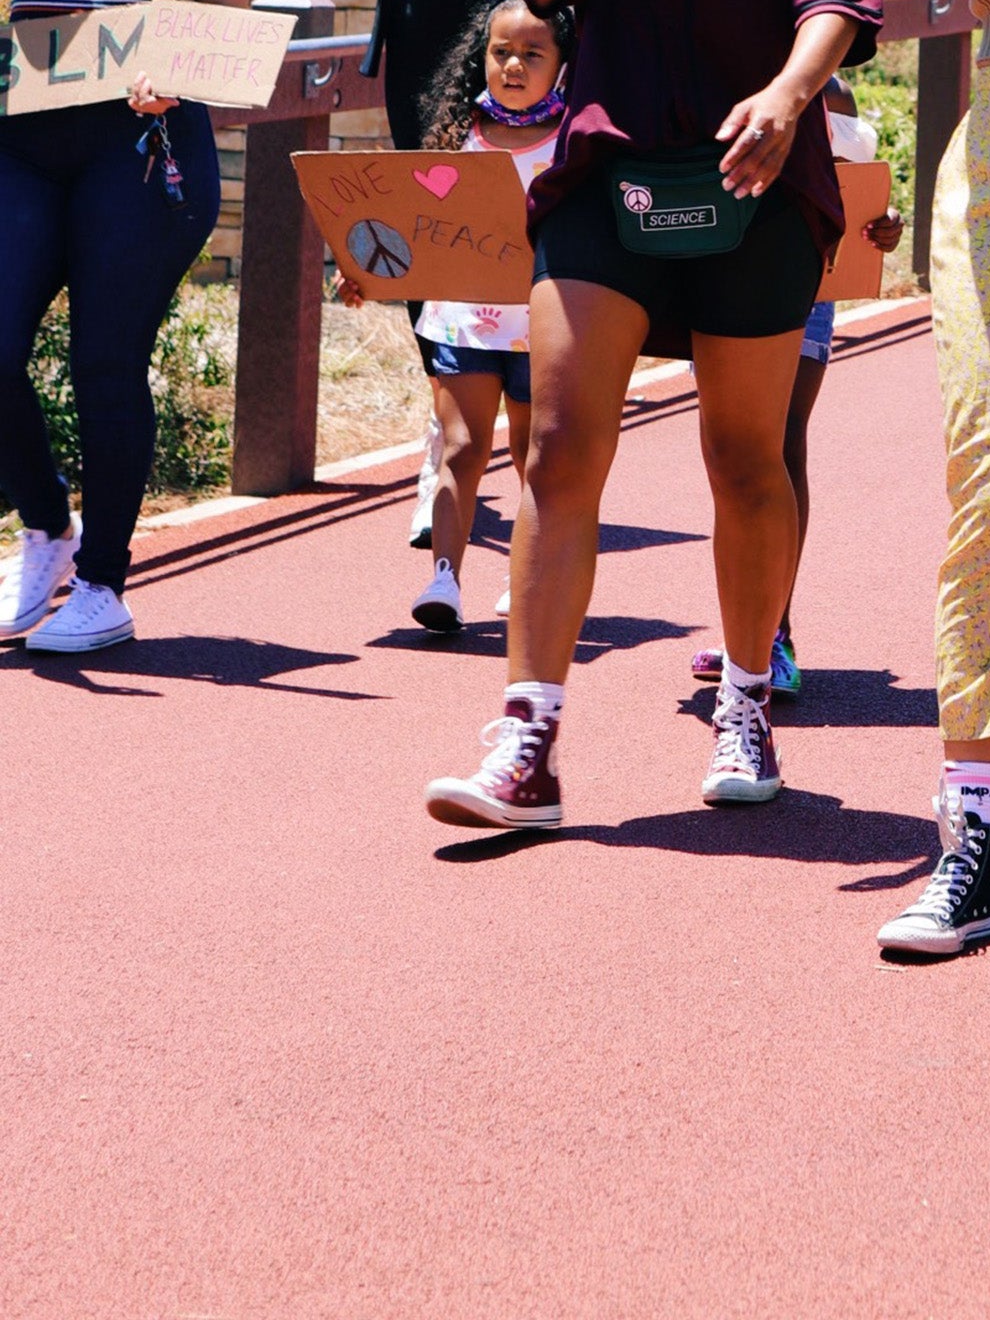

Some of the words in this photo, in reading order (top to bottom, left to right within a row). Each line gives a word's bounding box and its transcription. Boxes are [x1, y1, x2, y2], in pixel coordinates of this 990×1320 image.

[155, 7, 216, 40] BLACK
[222, 17, 284, 44] LIVES
[169, 50, 259, 87] MATTER
[311, 161, 393, 218] LOVE
[412, 213, 524, 261] PEACE
[648, 210, 707, 227] SCIENCE
